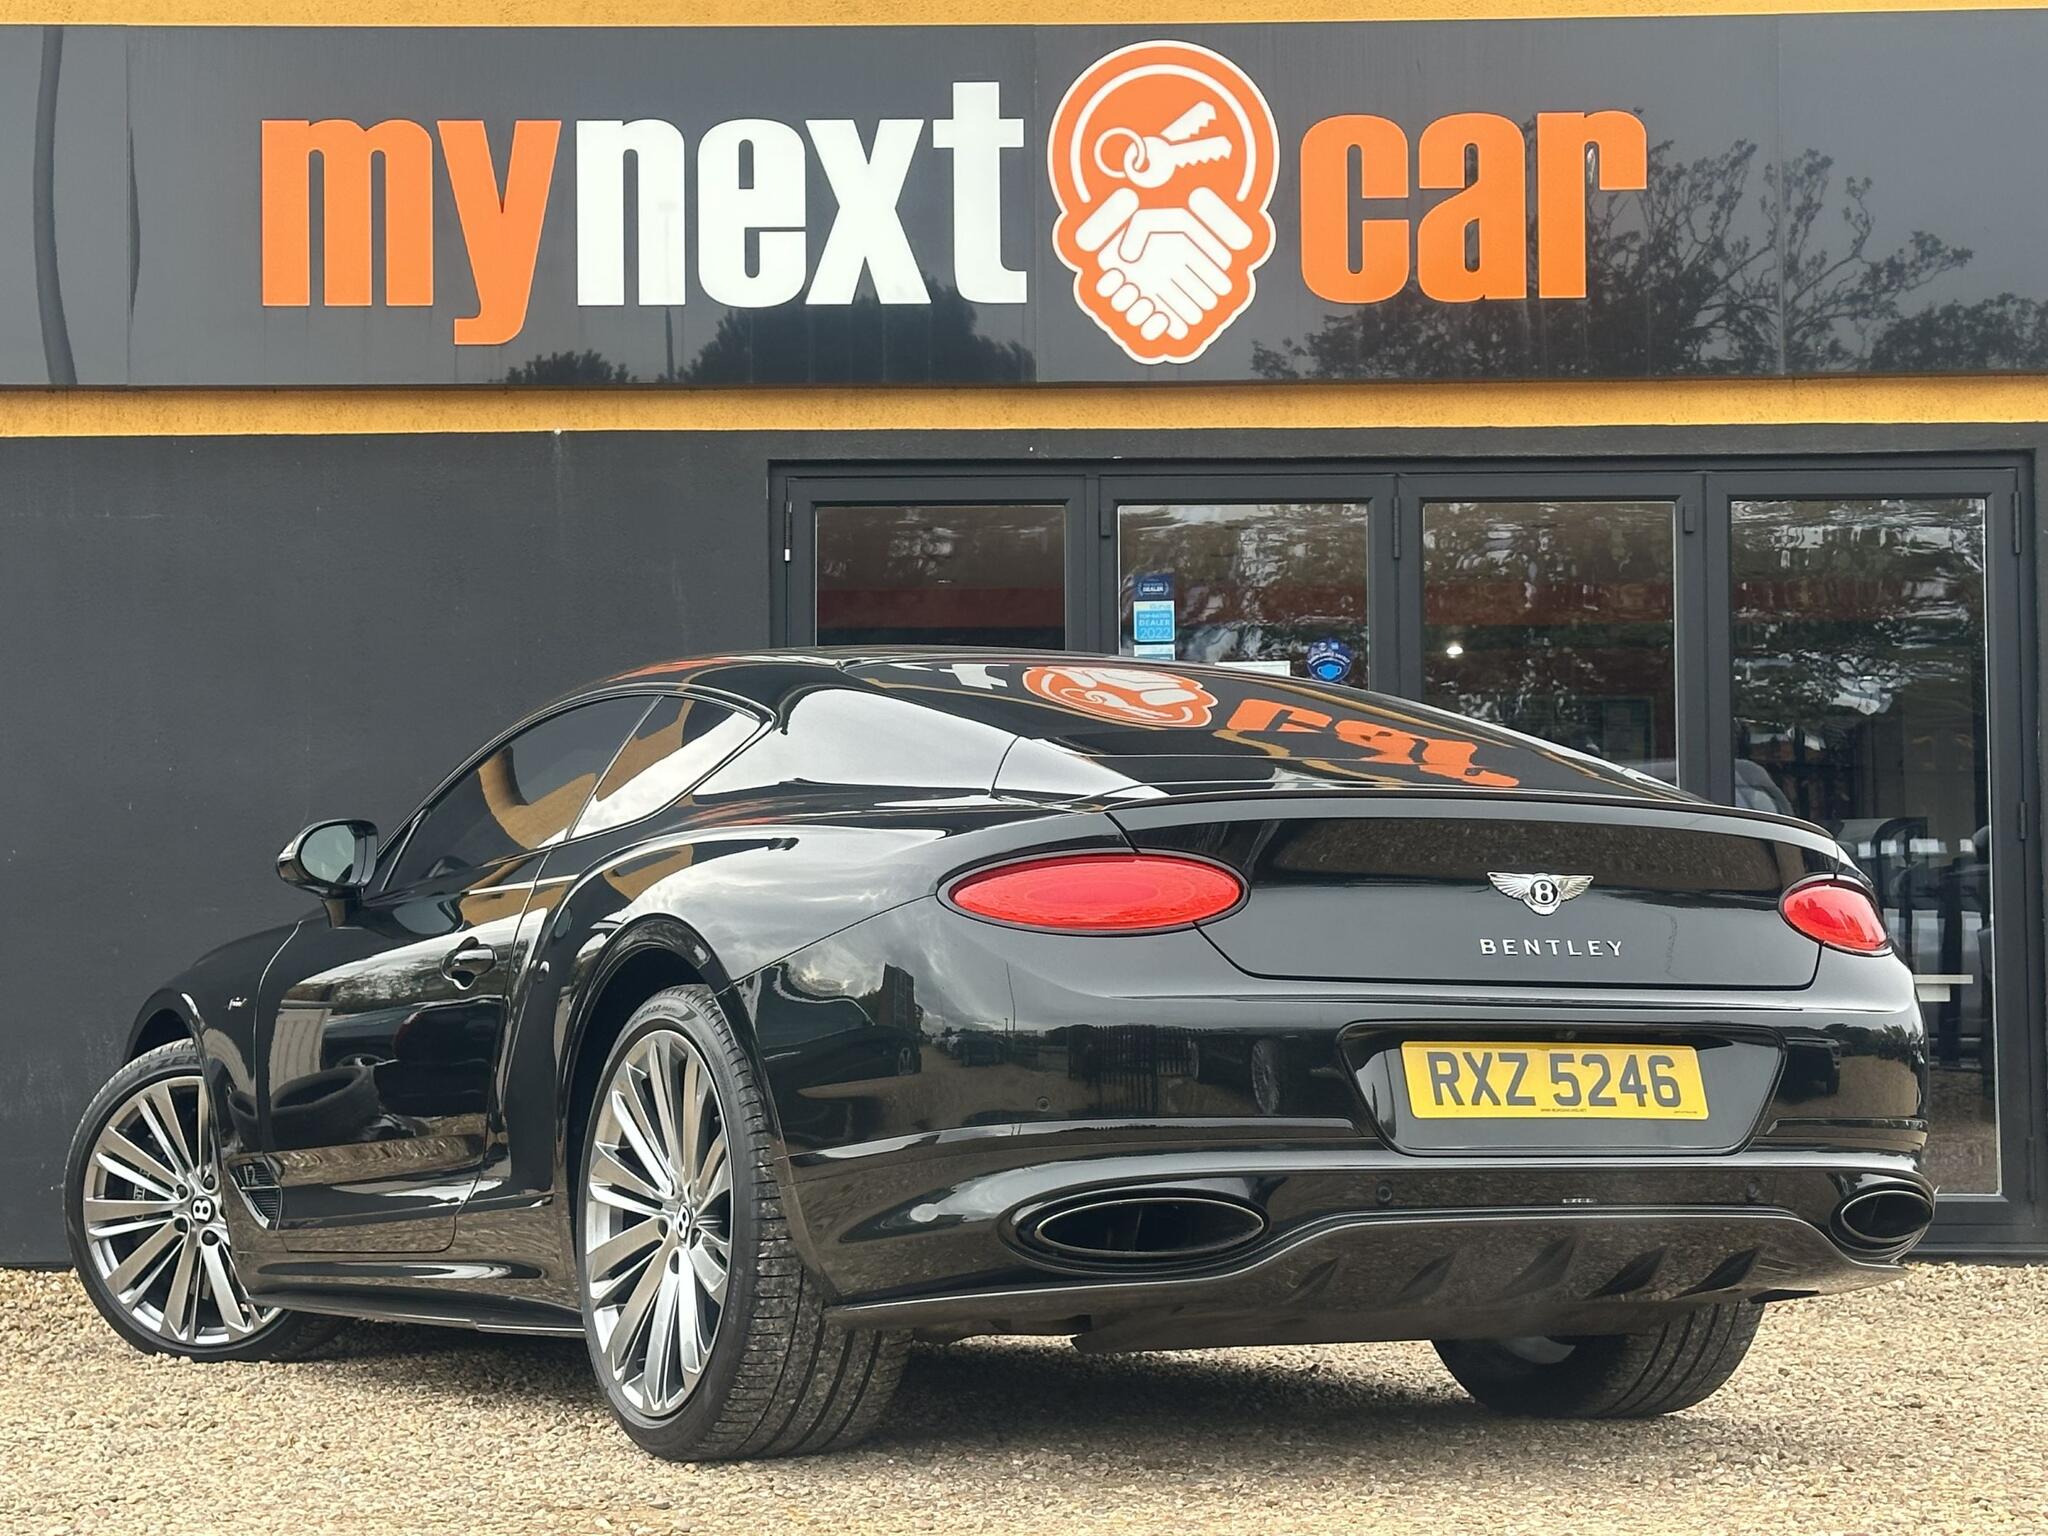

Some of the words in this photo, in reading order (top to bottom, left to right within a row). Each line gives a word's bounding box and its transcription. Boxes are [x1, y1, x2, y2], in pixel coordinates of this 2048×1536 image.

[1300, 110, 1647, 303] car
[1140, 627, 1170, 639] 2022
[1479, 938, 1623, 957] BENTLEY
[1426, 1051, 1537, 1107] RXZ
[1549, 1053, 1683, 1108] 5246
